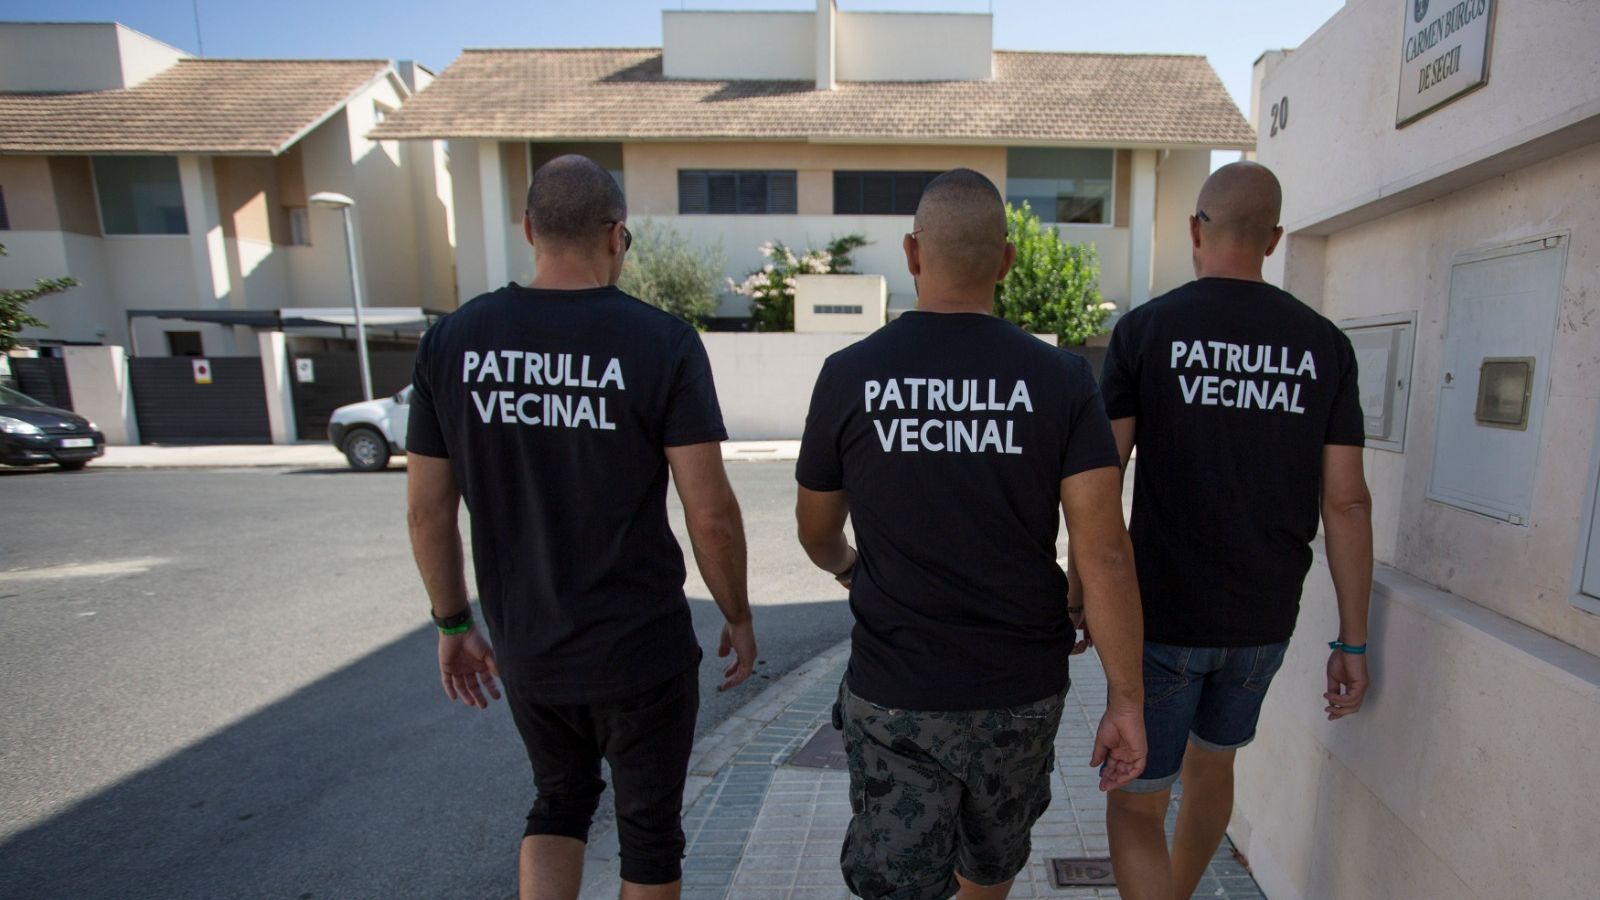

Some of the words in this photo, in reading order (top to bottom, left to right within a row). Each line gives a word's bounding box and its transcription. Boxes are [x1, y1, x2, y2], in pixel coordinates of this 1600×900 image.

[1405, 14, 1445, 63] CARMEN
[1445, 0, 1486, 39] BURGOS
[1418, 63, 1432, 94] DE
[1431, 44, 1462, 87] SEGUI
[1270, 96, 1289, 138] 20
[462, 350, 626, 391] PATRULLA
[1171, 340, 1317, 380] PATRULLA
[470, 390, 617, 430] VECINAL
[864, 377, 1034, 413] PATRULLA
[1178, 375, 1306, 415] VECINAL
[873, 418, 1023, 455] VECINAL
